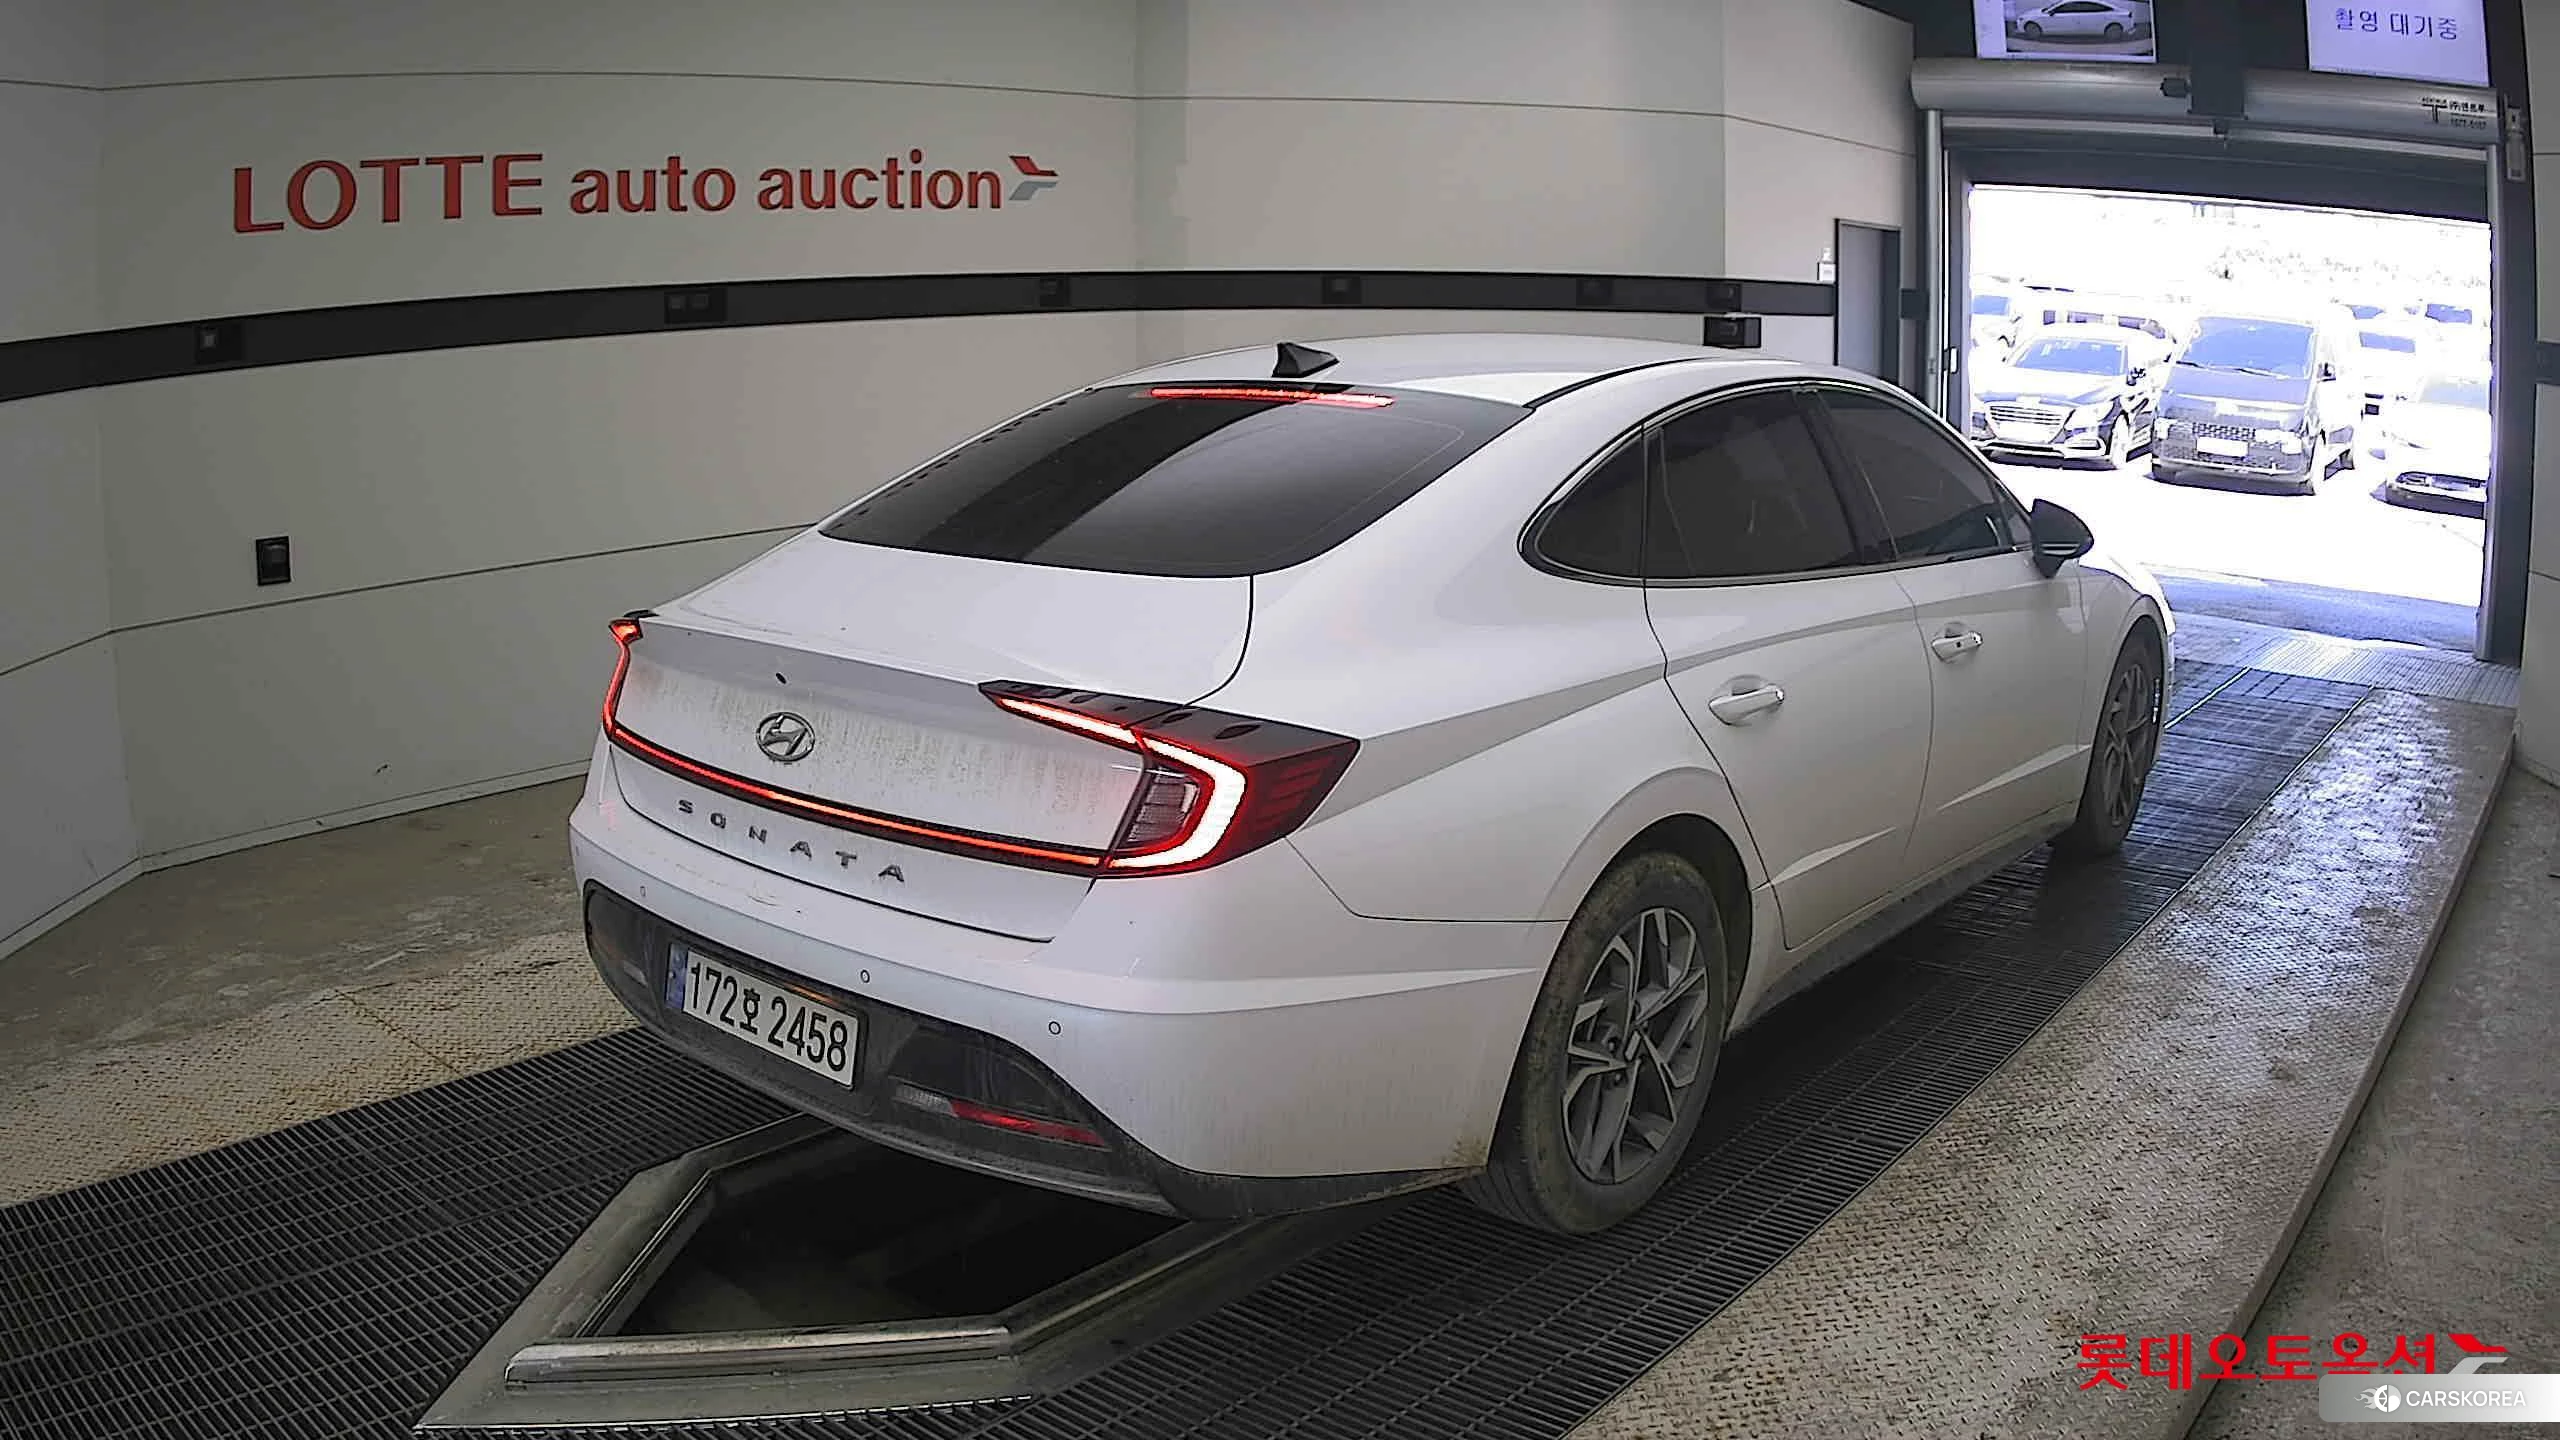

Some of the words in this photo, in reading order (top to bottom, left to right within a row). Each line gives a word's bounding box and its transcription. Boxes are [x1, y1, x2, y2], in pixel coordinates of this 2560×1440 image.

[2336, 8, 2378, 32] 촬영
[2390, 13, 2457, 40] 대기중
[234, 153, 544, 233] LOTTE
[570, 156, 736, 213] auto
[757, 150, 1003, 210] auction
[678, 799, 904, 882] SONATA
[690, 962, 760, 1035] 172호
[767, 996, 848, 1072] 2458
